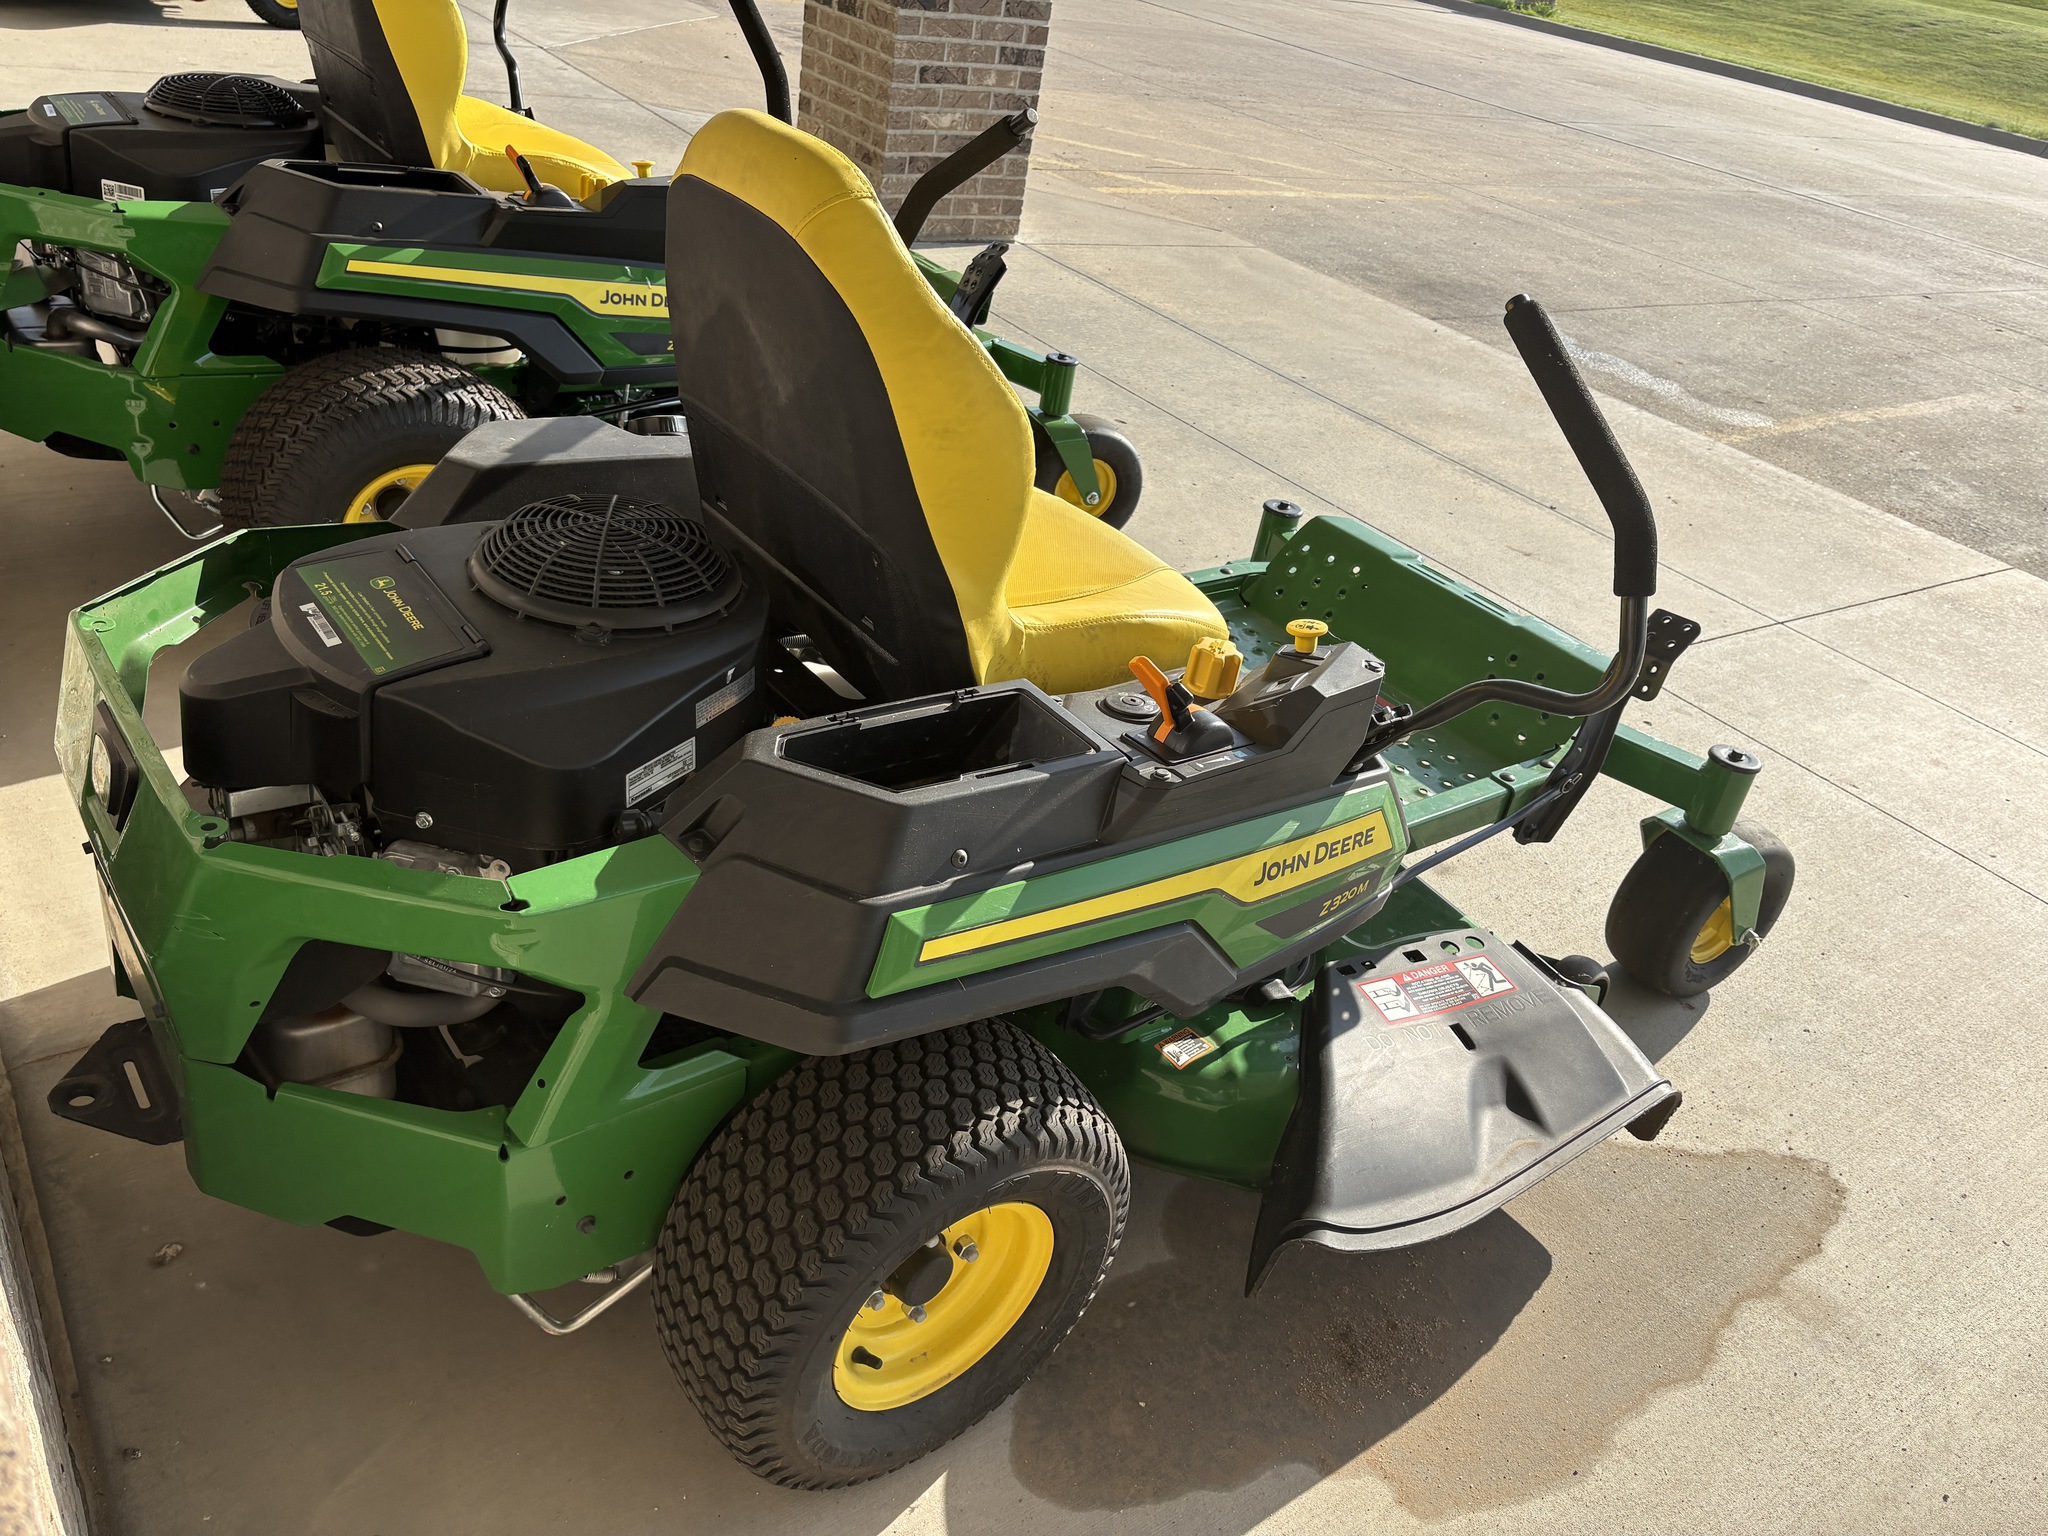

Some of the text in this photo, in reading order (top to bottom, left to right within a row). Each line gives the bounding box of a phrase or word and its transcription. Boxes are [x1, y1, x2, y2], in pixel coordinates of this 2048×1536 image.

[600, 290, 647, 307] JOHN
[314, 582, 333, 597] 21.5
[383, 589, 406, 611] JOHN
[400, 605, 425, 631] DEERE
[1253, 826, 1376, 887] JOHN DEERE
[1318, 879, 1370, 918] Z320M
[1410, 964, 1451, 980] DANGER
[1362, 1032, 1397, 1051] DO
[1402, 1021, 1445, 1045] NOT
[1464, 988, 1550, 1028] REMOVE
